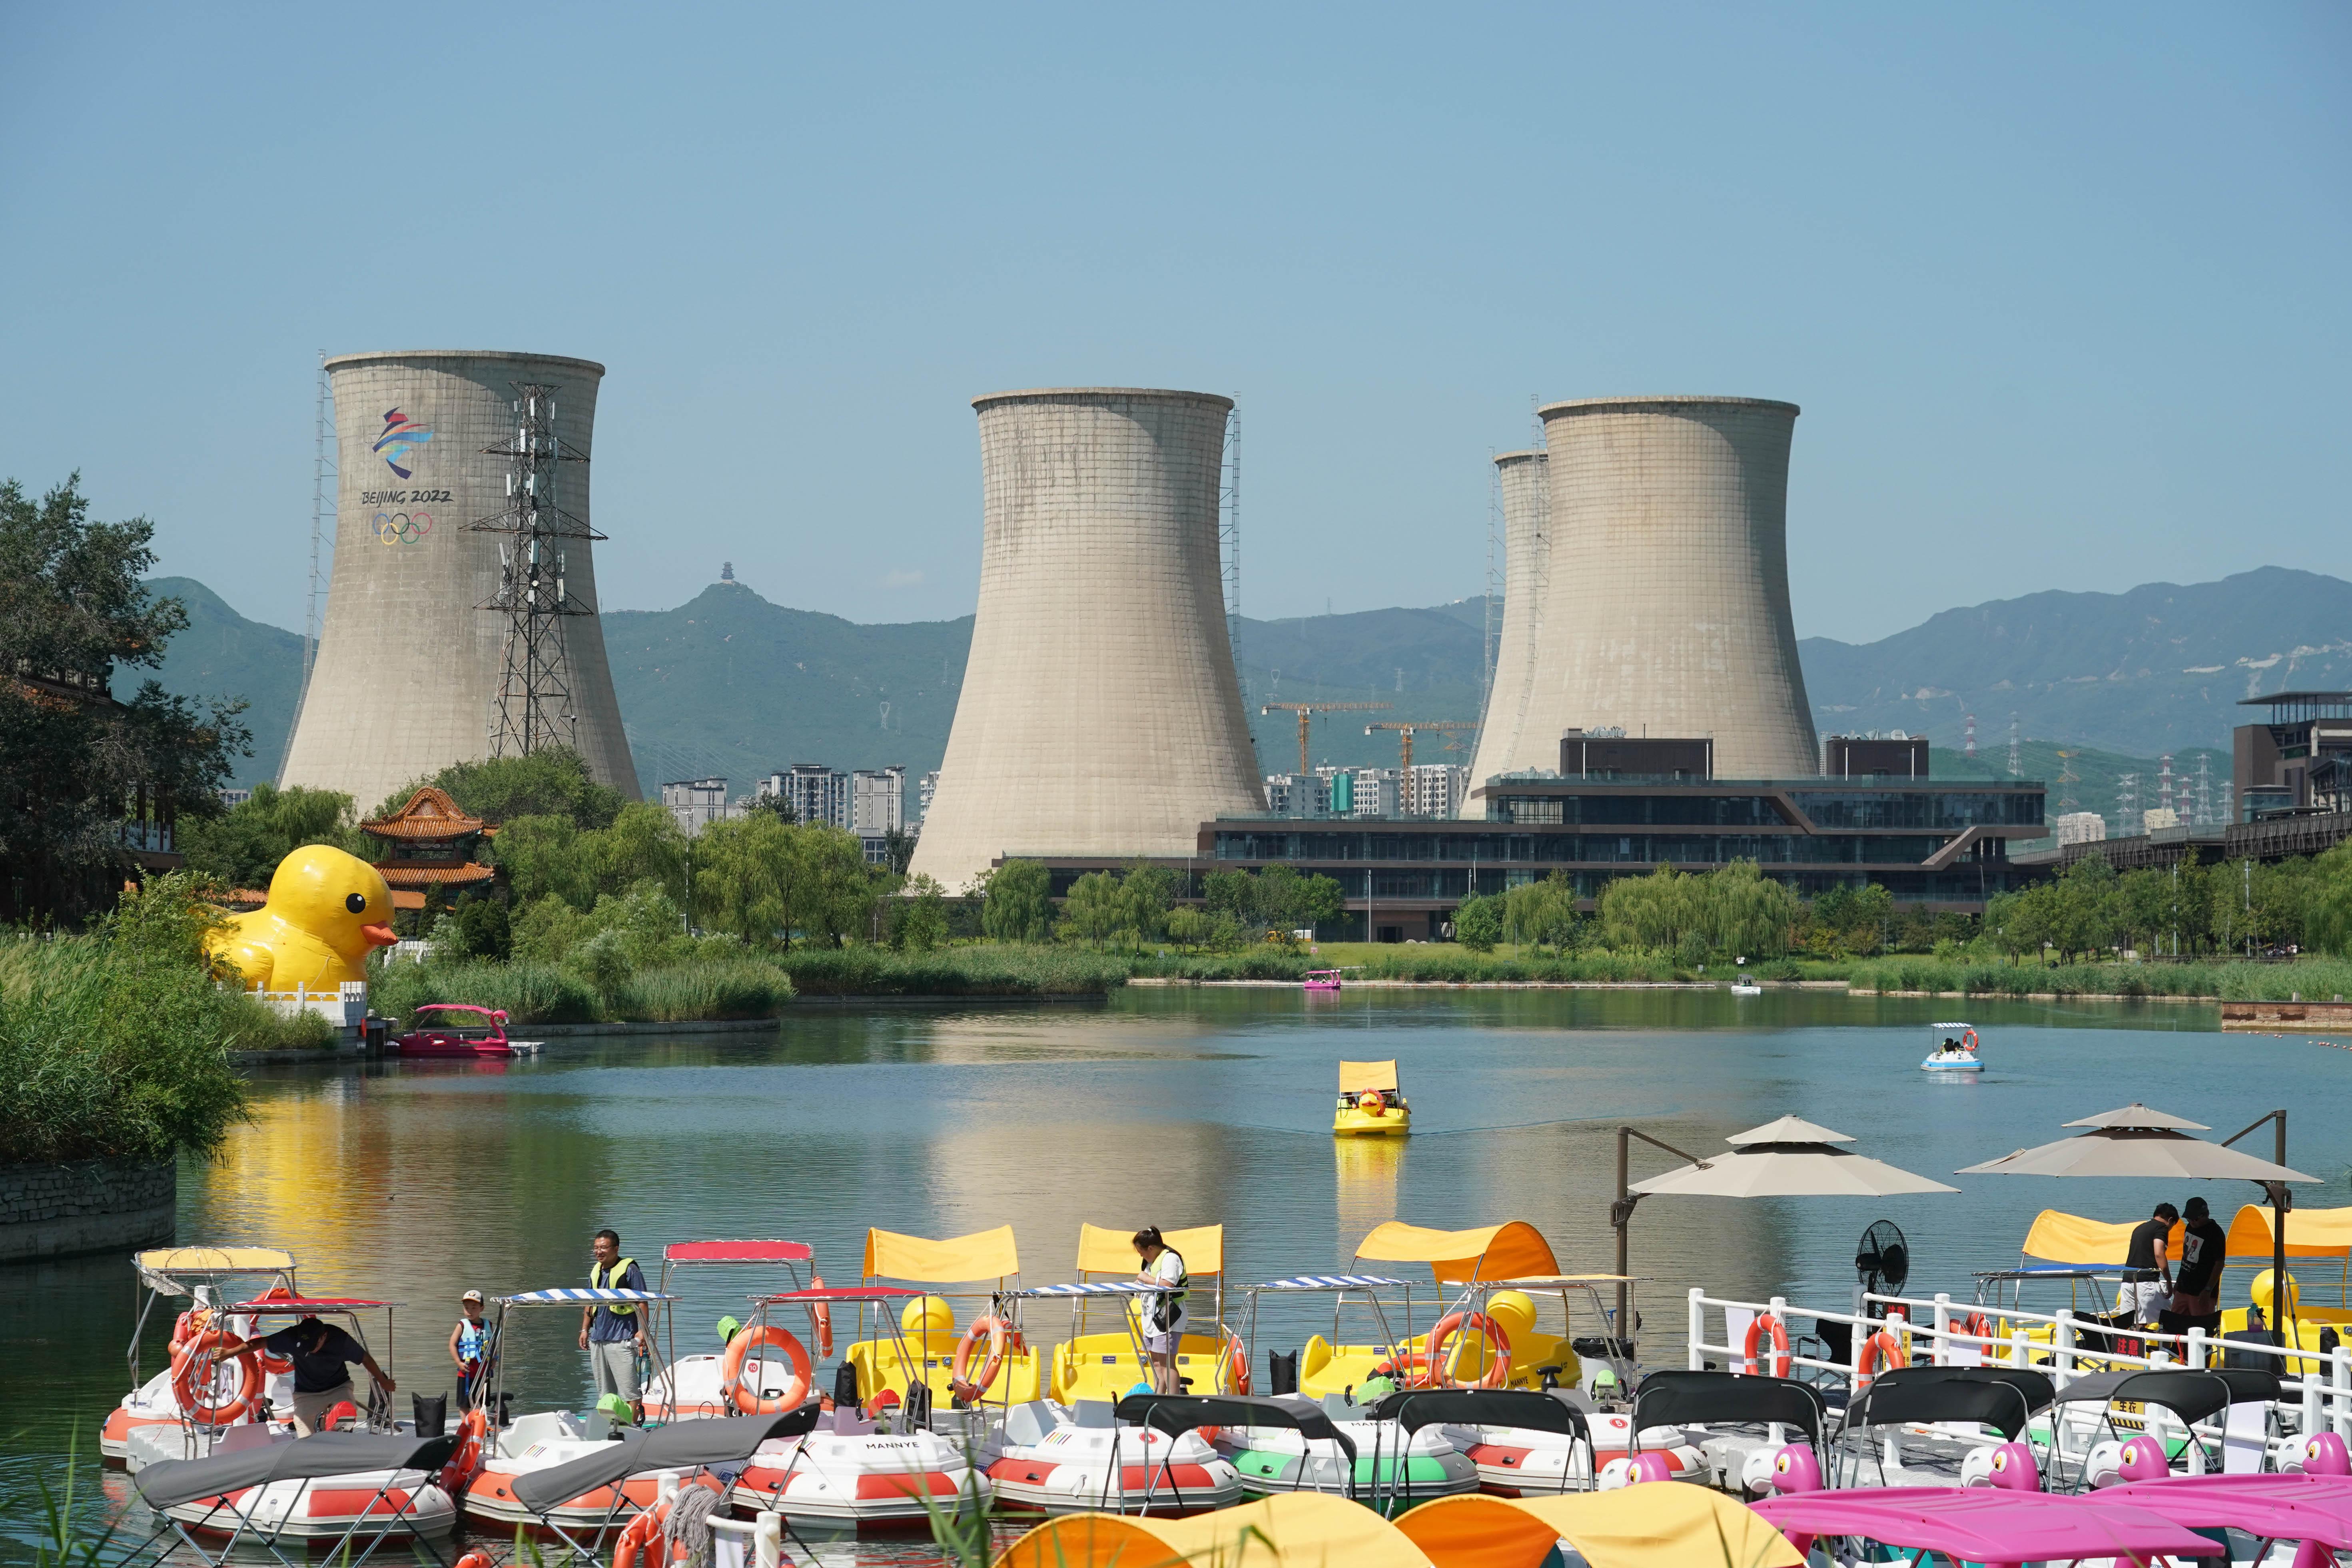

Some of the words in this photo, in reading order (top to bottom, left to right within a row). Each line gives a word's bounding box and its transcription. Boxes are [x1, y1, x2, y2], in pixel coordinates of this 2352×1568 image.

[362, 491, 406, 508] BEIJING
[411, 490, 455, 503] 2022
[2117, 1338, 2139, 1356] 注意
[1510, 1376, 1529, 1387] MANNYE
